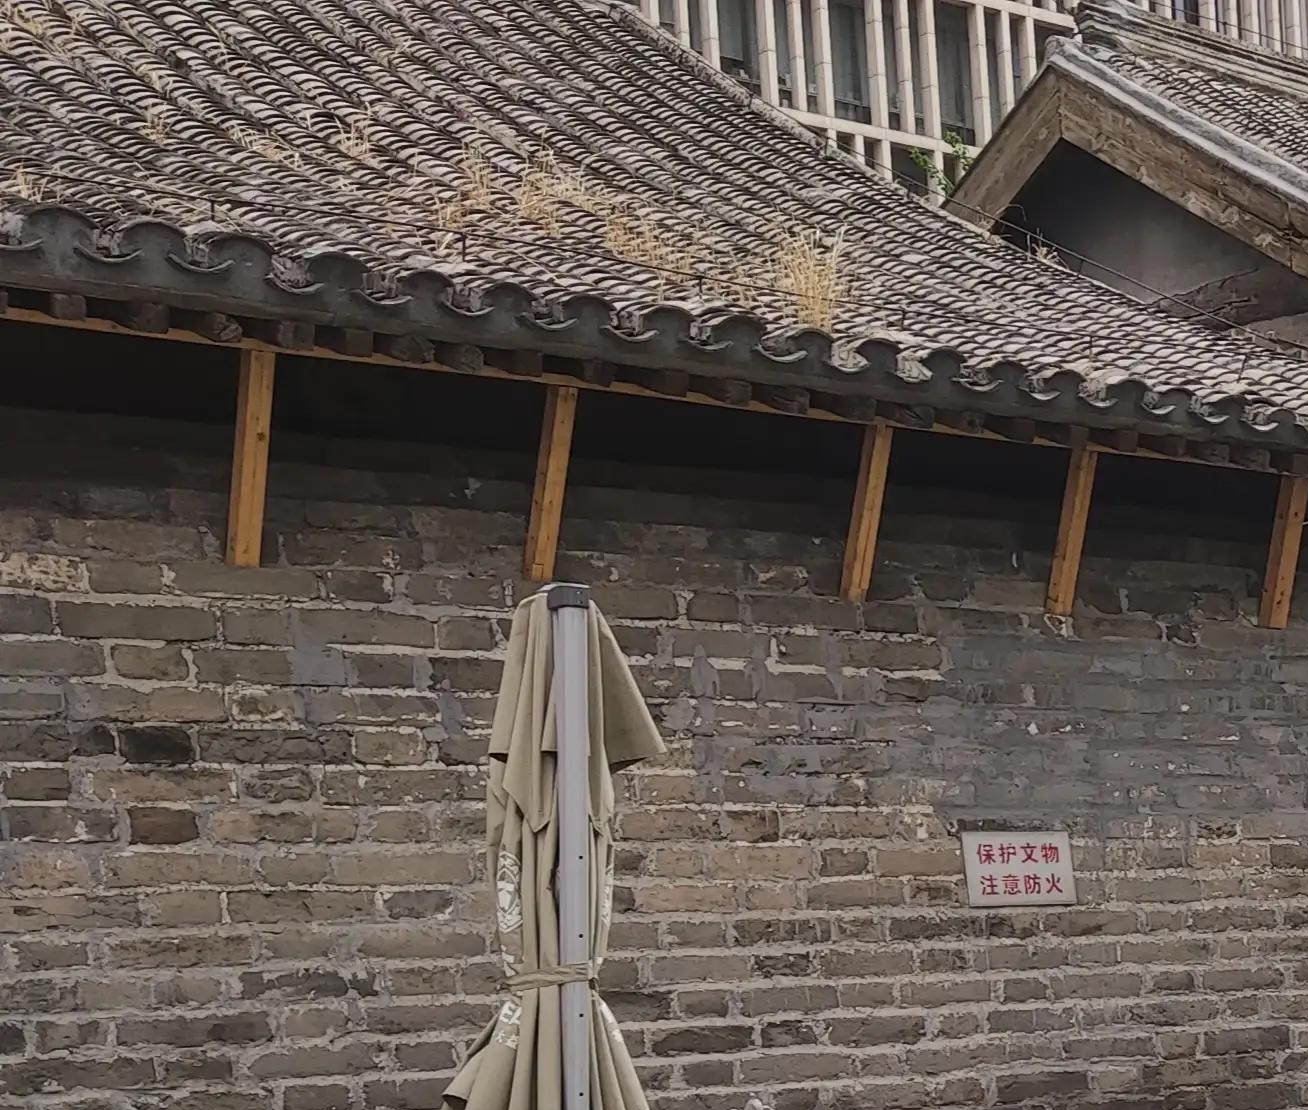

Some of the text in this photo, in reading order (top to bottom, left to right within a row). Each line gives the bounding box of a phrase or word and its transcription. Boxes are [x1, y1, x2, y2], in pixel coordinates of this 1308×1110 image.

[976, 842, 1060, 864] 保护文物
[980, 873, 1064, 896] 注意防火
